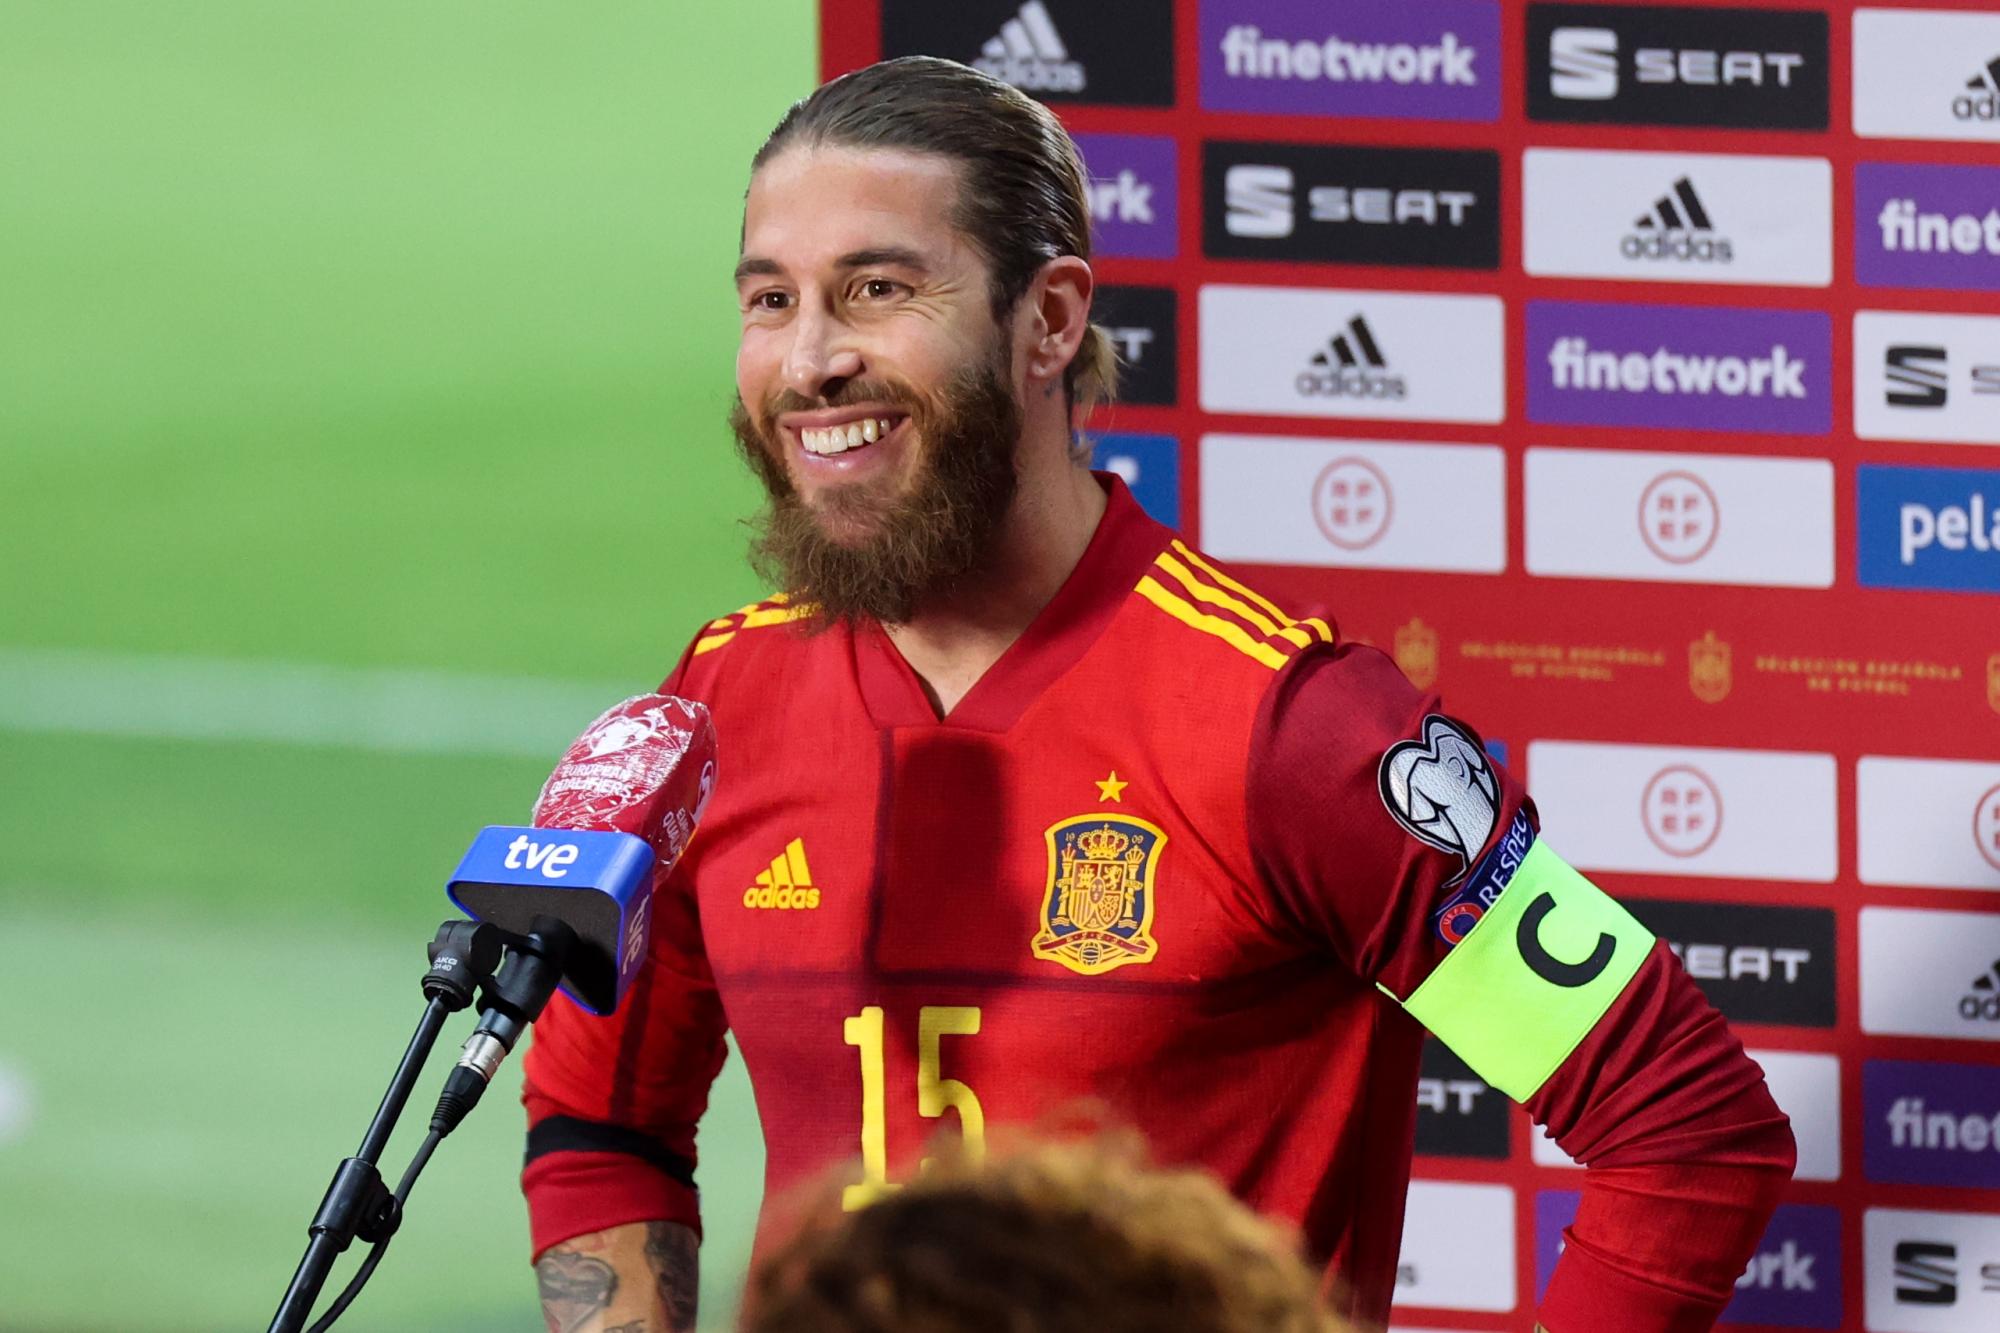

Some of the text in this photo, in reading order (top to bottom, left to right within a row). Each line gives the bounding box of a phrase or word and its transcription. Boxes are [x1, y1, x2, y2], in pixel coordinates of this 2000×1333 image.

[1222, 24, 1476, 85] finetwork
[1635, 48, 1803, 87] SEAT
[1308, 187, 1474, 226] SEAT
[1621, 229, 1733, 263] adidas
[1295, 366, 1406, 399] adidas
[1549, 338, 1805, 398] finetwork
[504, 834, 579, 879] tve
[743, 883, 821, 910] adidas
[1516, 891, 1617, 988] C
[842, 1006, 986, 1212] 15
